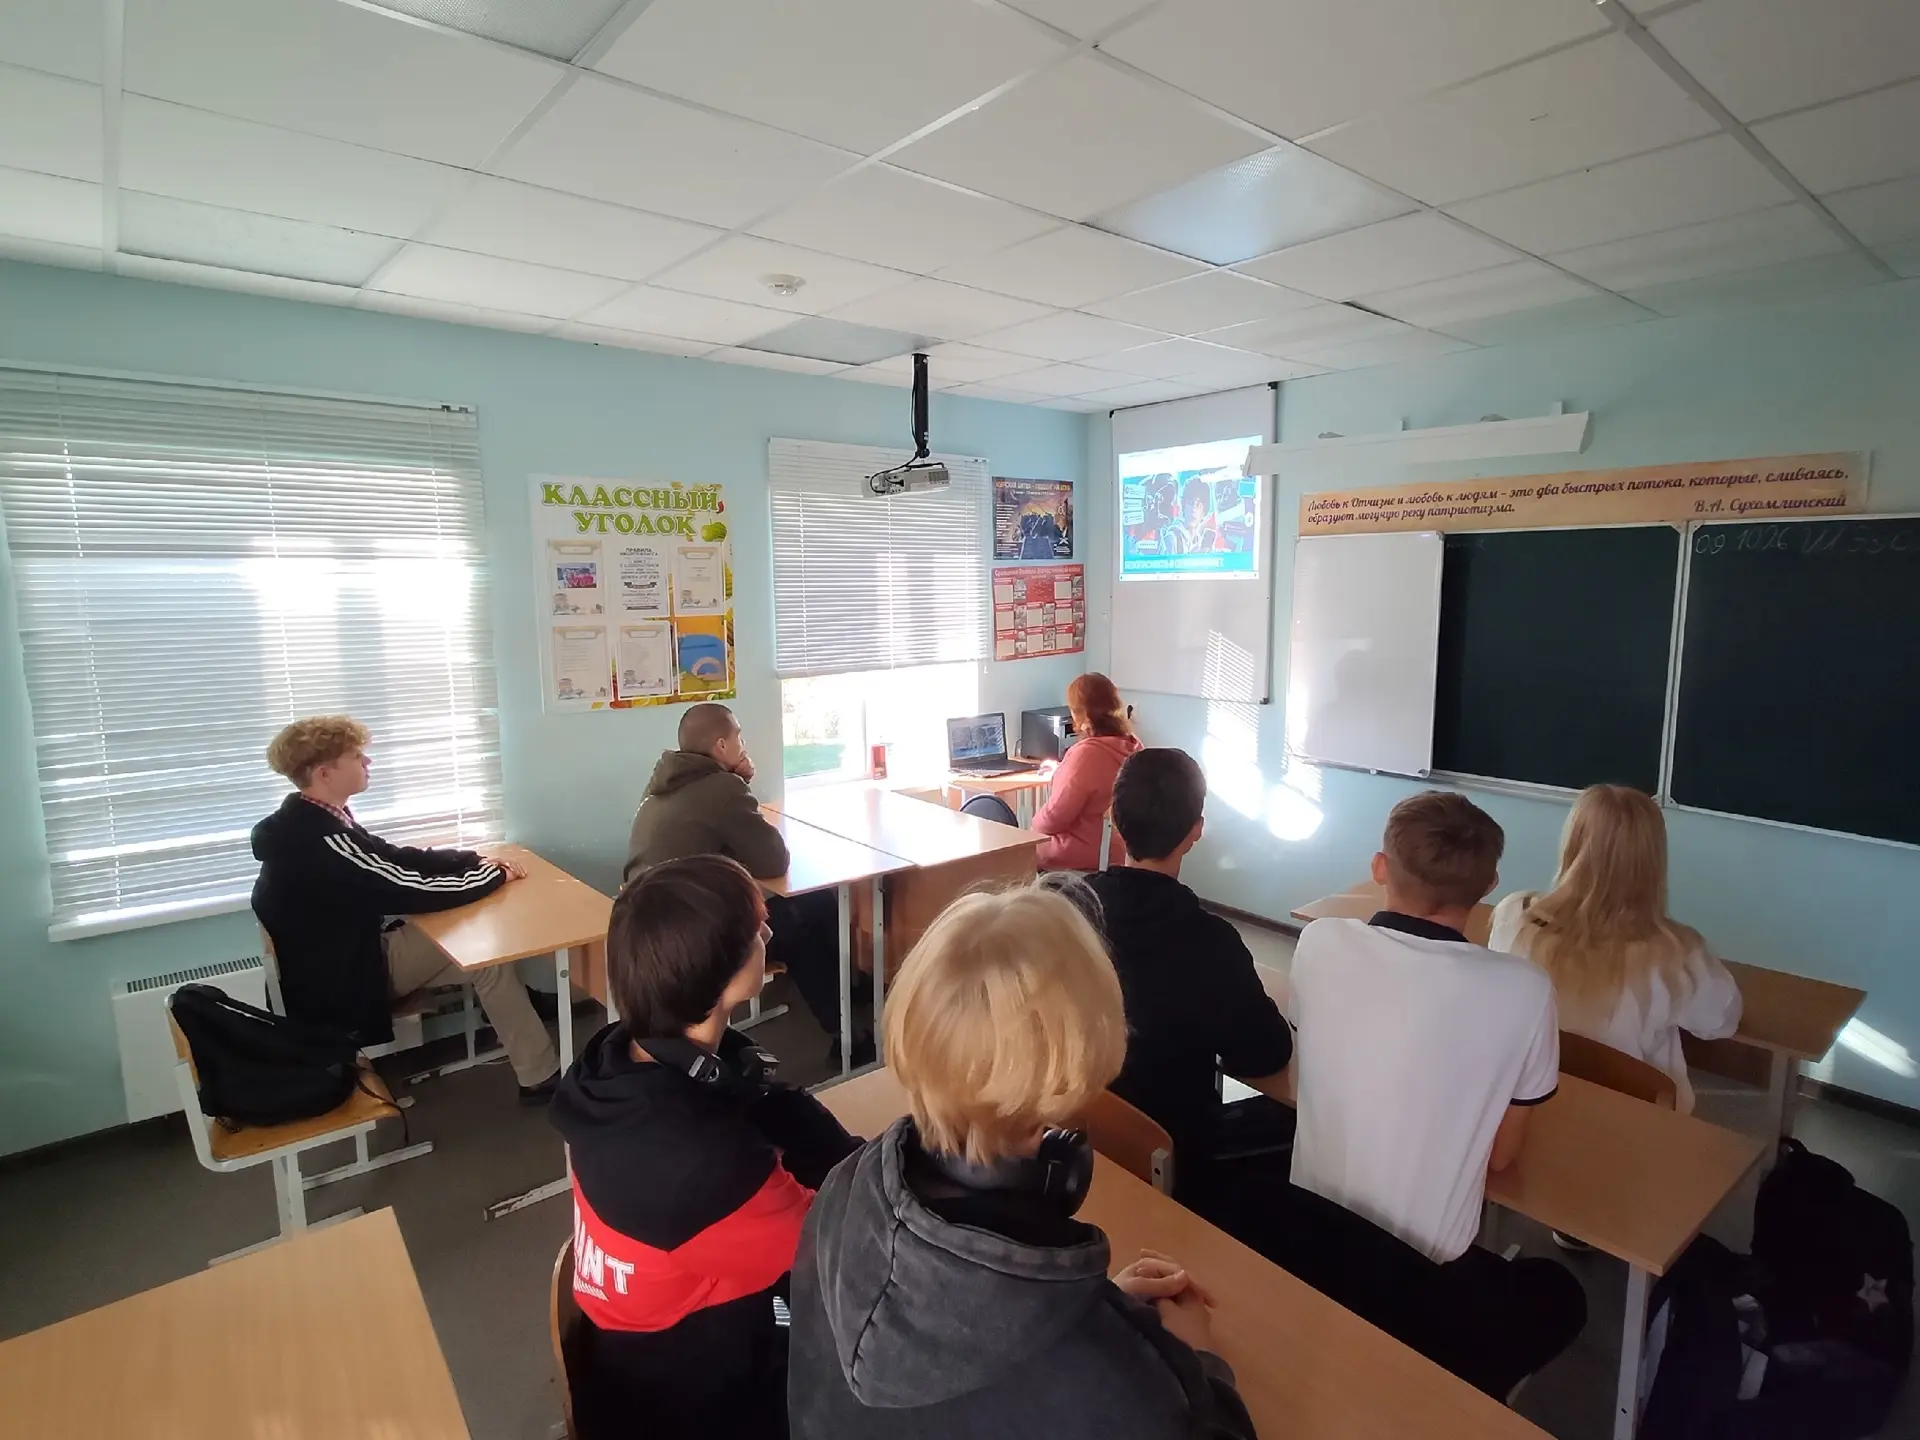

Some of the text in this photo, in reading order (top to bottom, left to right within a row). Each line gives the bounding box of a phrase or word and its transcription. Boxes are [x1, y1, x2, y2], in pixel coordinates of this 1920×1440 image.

[541, 482, 719, 512] КЛАССНЫЙ
[1308, 500, 1341, 511] Любовь
[1342, 500, 1349, 508] к
[1351, 497, 1395, 511] Отчизне
[1397, 497, 1403, 505] и
[1405, 492, 1444, 504] любовь
[1446, 493, 1453, 502] к
[1455, 491, 1498, 503] людям
[1509, 488, 1533, 498] это
[1536, 483, 1560, 499] два
[1561, 480, 1624, 495] быстрых
[1627, 477, 1685, 491] потока,
[1729, 493, 1847, 514] Сухомлинский
[572, 511, 697, 536] УГОЛОК
[1308, 502, 1515, 525] образуют могучую реку патриотизма.
